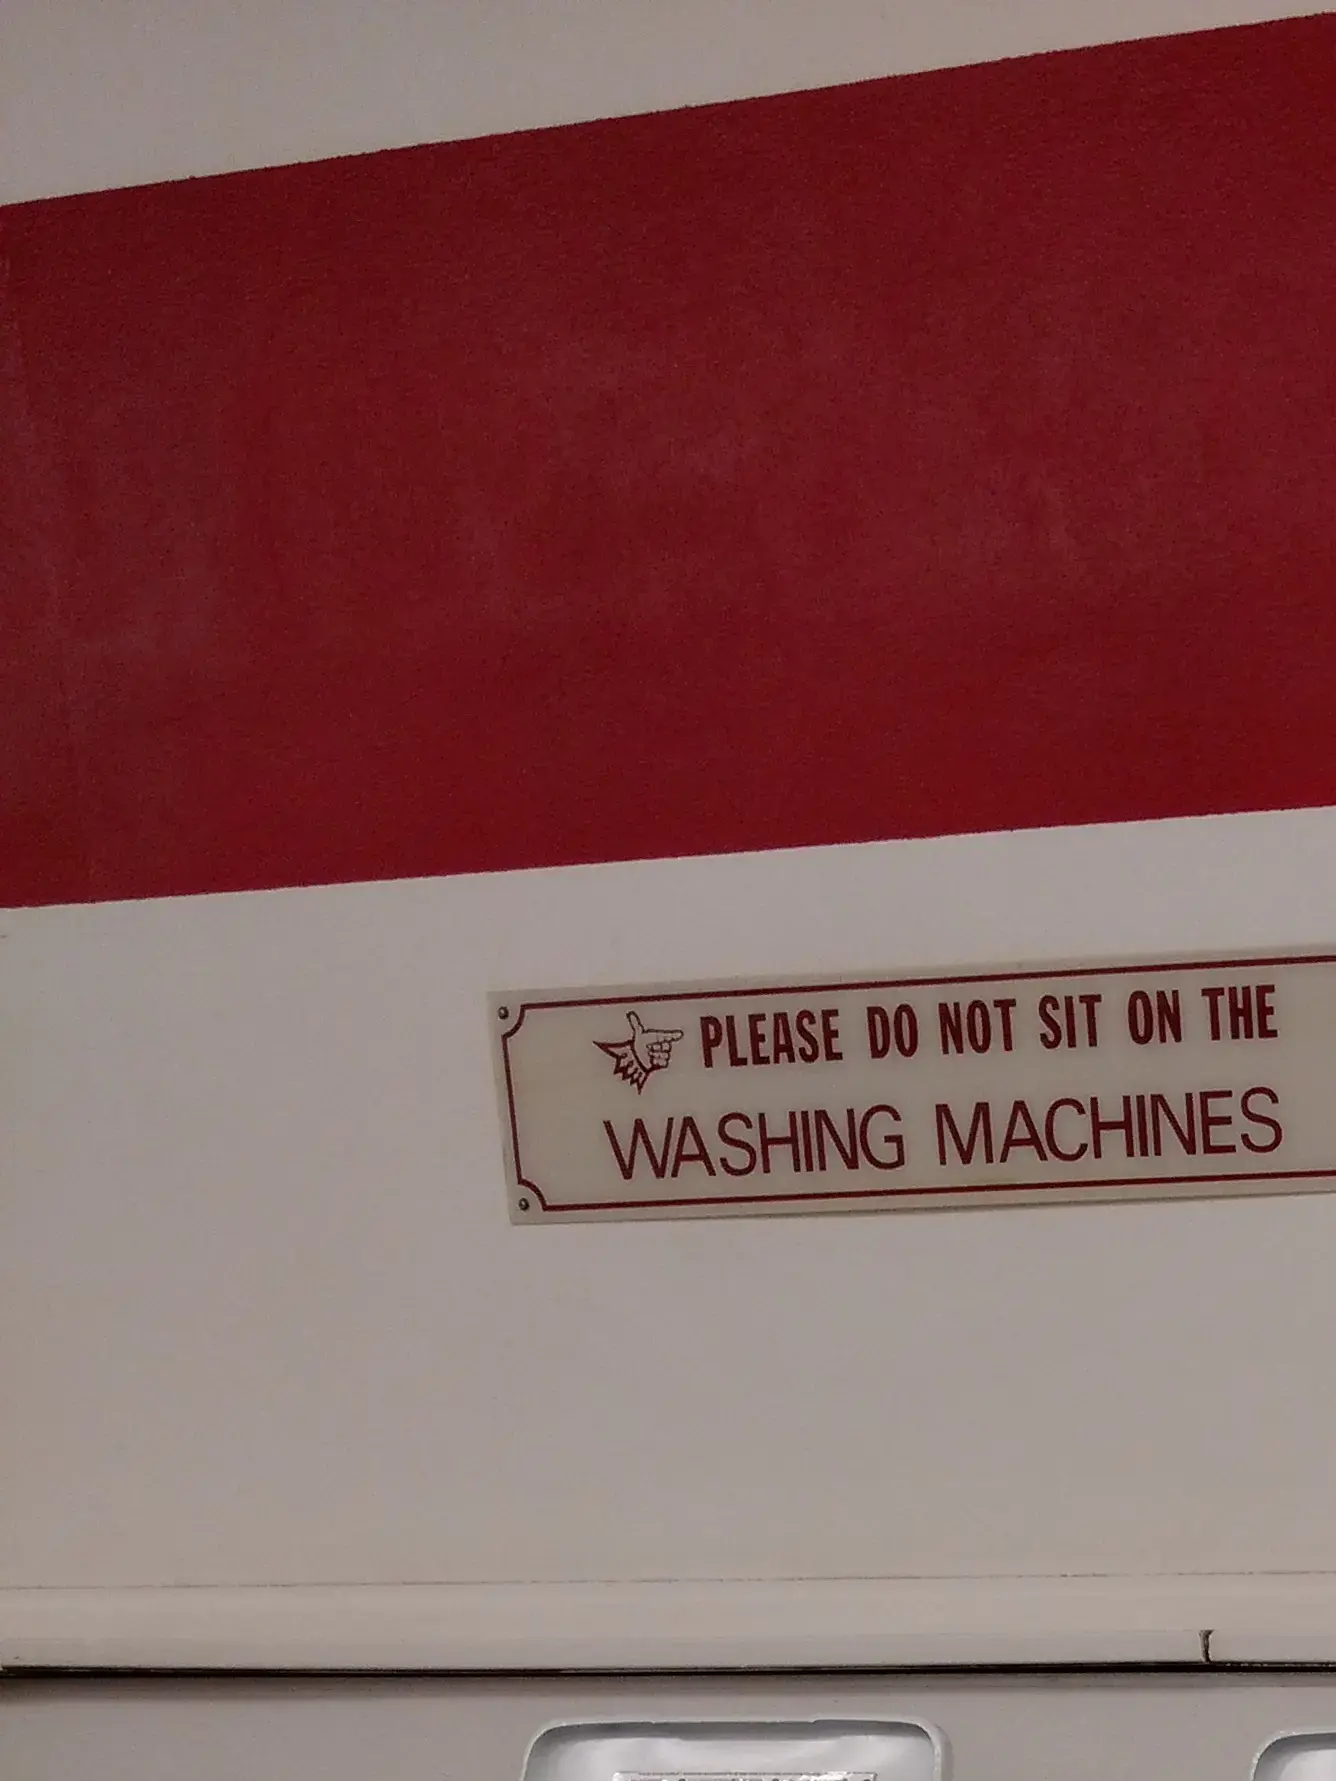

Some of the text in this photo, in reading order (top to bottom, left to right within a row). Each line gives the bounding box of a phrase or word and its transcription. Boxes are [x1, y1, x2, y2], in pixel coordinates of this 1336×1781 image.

[700, 984, 1278, 1069] PLEASE DO NOT SIT ON THE
[602, 1086, 1284, 1181] WASHING MACHINES
